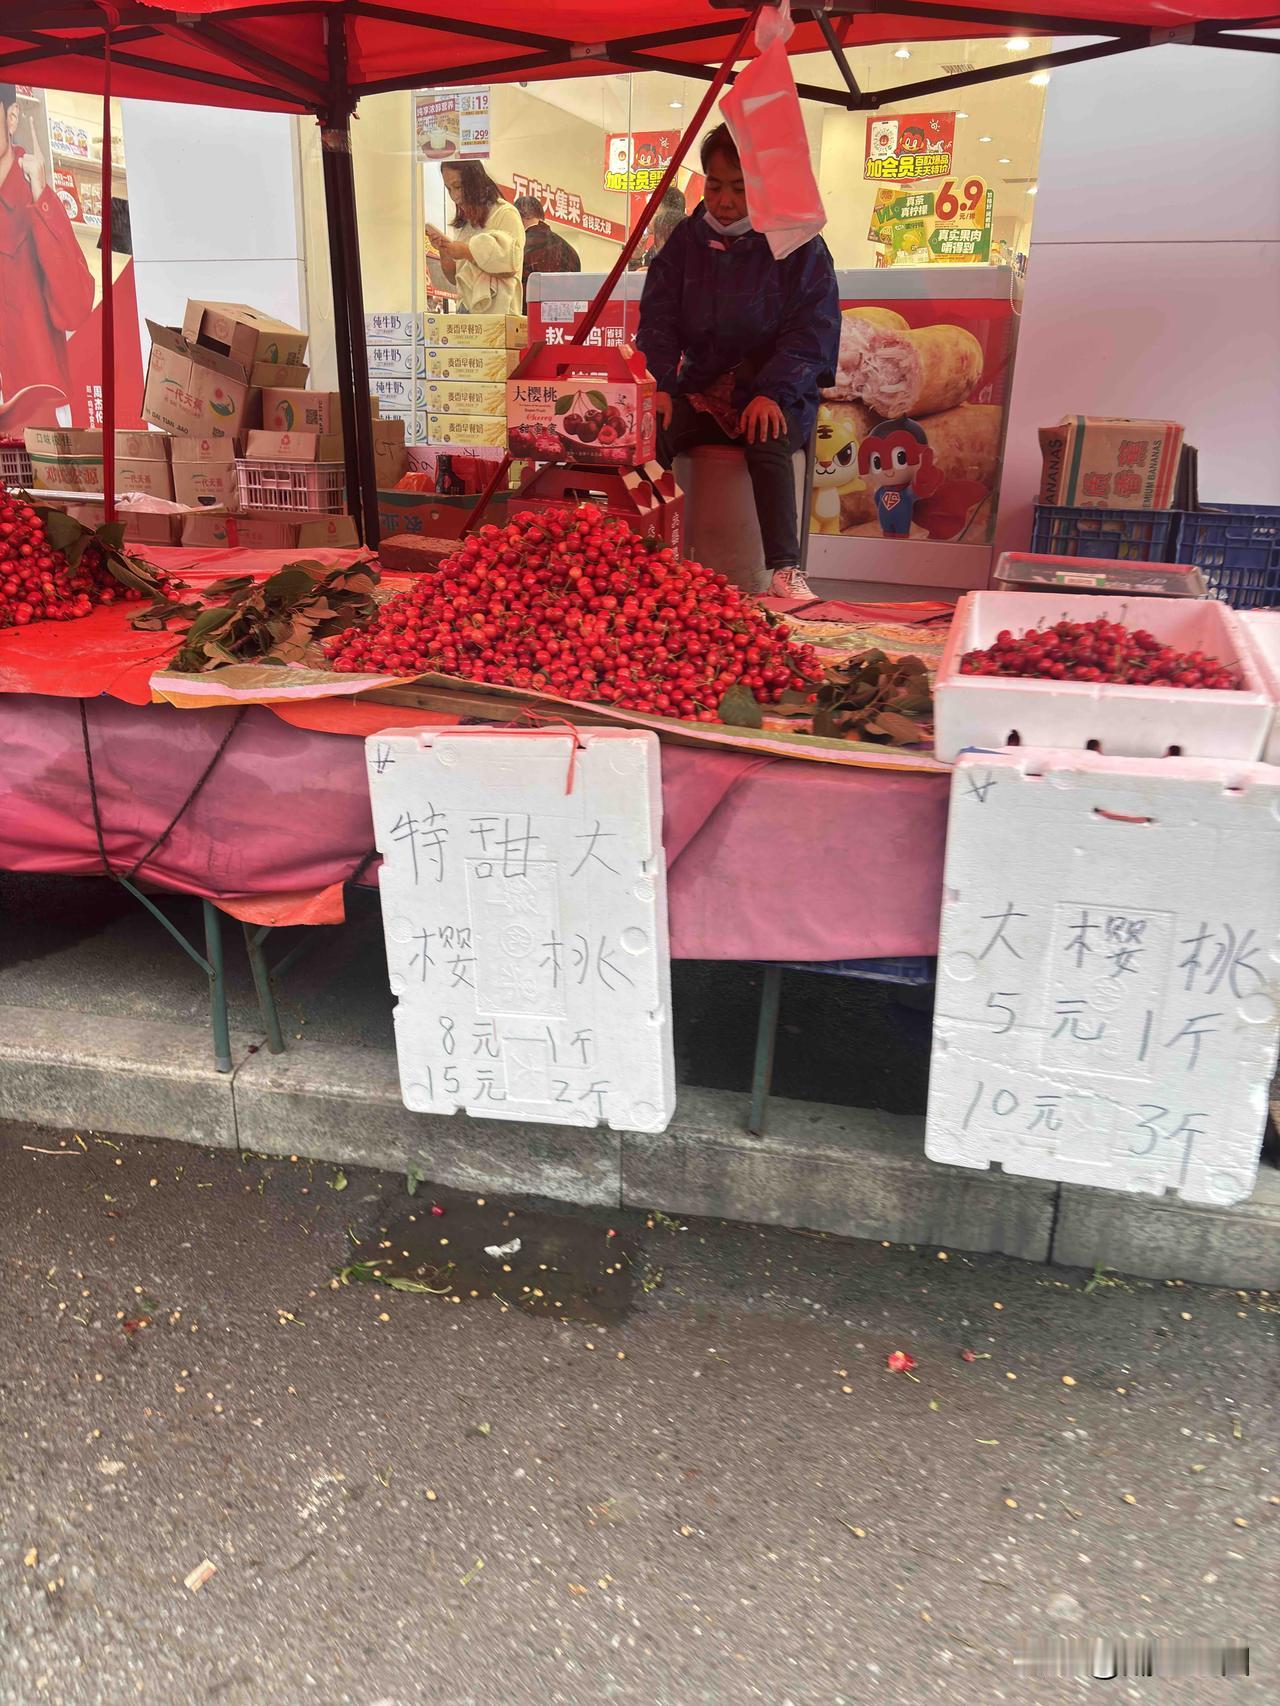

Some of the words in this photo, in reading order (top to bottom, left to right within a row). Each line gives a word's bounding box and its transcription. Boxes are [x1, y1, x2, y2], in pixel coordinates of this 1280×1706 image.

[866, 157, 915, 178] 加会员
[606, 170, 650, 191] 加会员
[935, 180, 984, 221] 6.9
[938, 230, 982, 242] 真实果肉
[373, 315, 402, 330] 纯牛奶
[446, 324, 483, 335] 麦香早餐奶
[373, 348, 402, 362] 纯牛奶
[448, 357, 484, 369] 麦香早餐奶
[375, 381, 404, 394] 纯牛奶
[512, 385, 558, 403] 大樱桃
[448, 391, 484, 403] 麦香早餐奶
[448, 423, 484, 434] 麦香早餐奶
[1148, 440, 1162, 482] BANANAS
